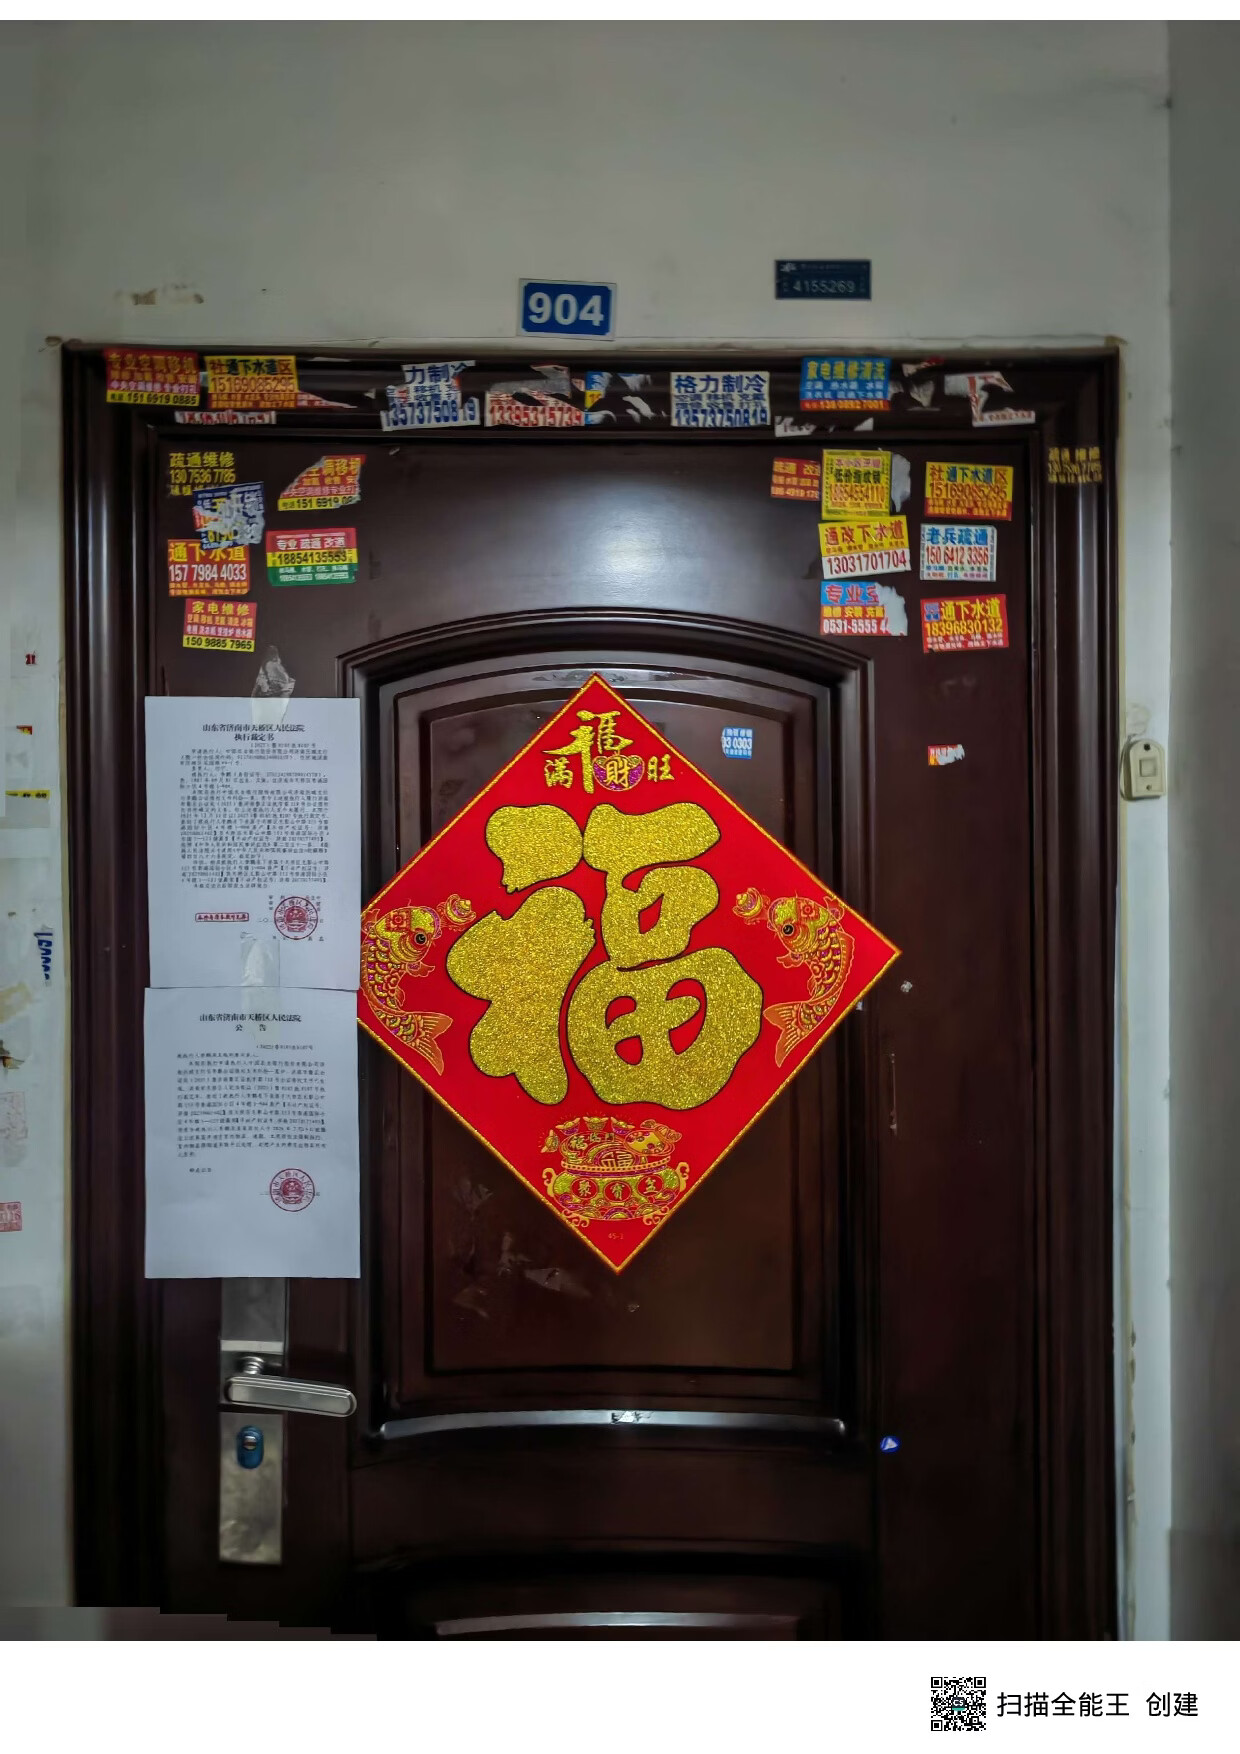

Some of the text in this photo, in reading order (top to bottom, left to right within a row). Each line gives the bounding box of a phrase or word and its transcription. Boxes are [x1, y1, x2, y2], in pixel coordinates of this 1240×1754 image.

[528, 292, 605, 327] 904
[674, 374, 767, 393] 格力制冷
[169, 451, 235, 467] 疏通维修
[825, 520, 904, 546] 通改下水道
[926, 527, 988, 545] 老兵疏通
[168, 542, 247, 562] 通下水道
[827, 549, 907, 575] 13031701704
[169, 563, 247, 582] 157 7984 4033
[192, 601, 250, 616] 家电维修
[941, 597, 1001, 621] 通下水道
[925, 618, 1003, 637] 18396830132
[186, 636, 253, 650] 150 9885 7965
[202, 723, 305, 733] 山东省济南市天桥区人民法院
[234, 733, 275, 742] 执行裁定书
[647, 754, 675, 782] 旺
[446, 802, 764, 1111] 福
[200, 1013, 302, 1023] 山东省济南市天桥区人民法院
